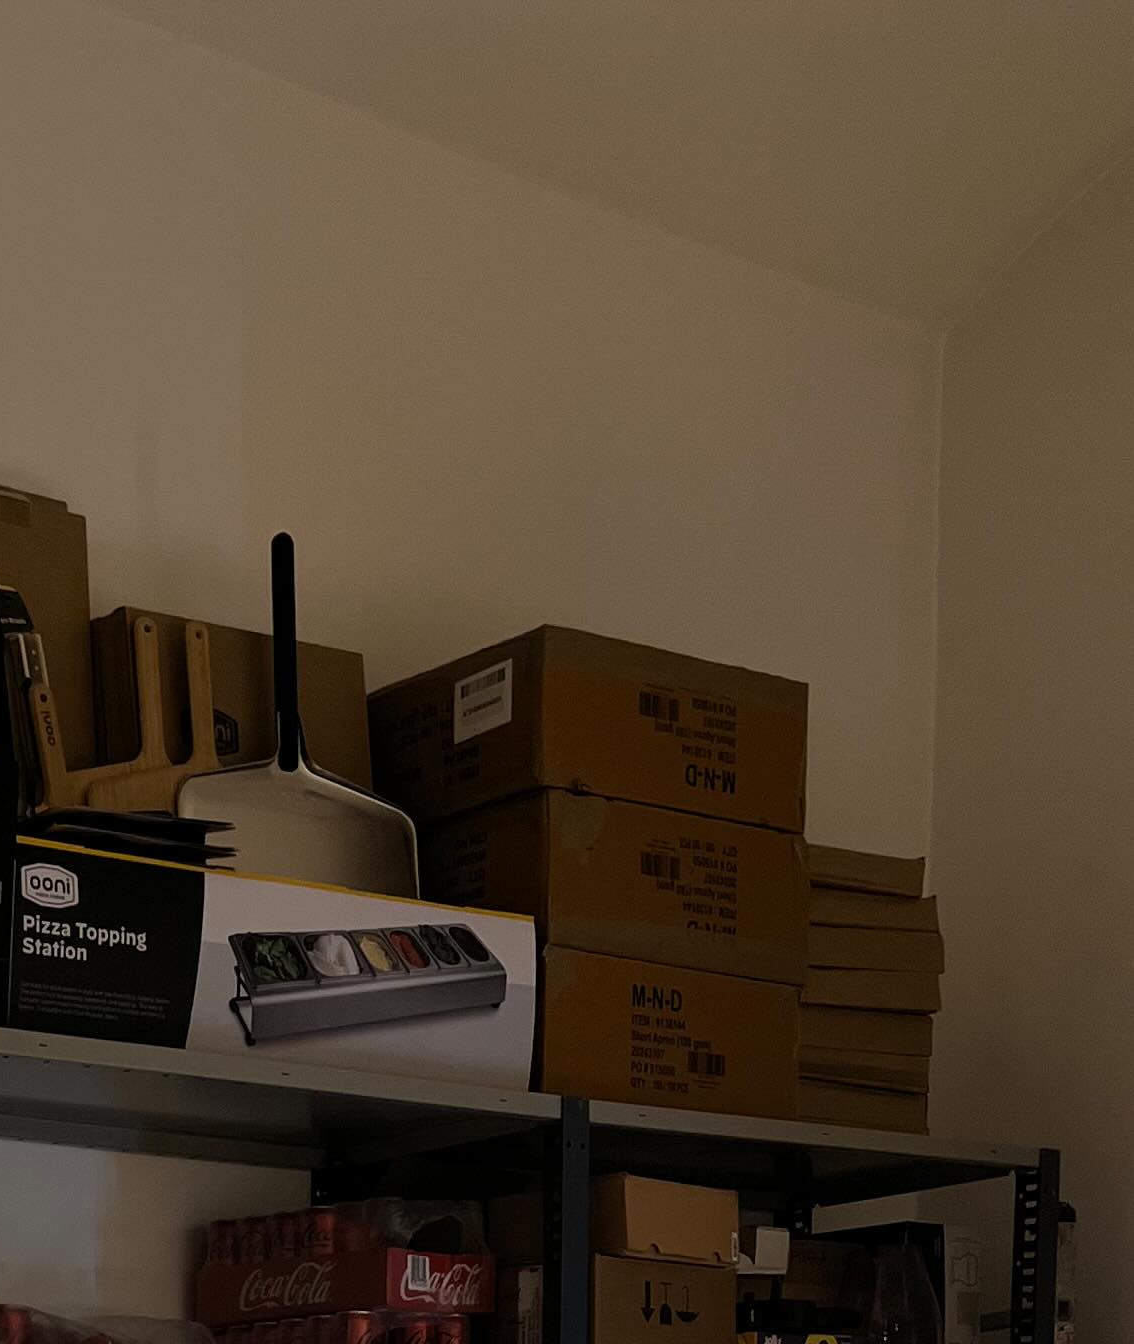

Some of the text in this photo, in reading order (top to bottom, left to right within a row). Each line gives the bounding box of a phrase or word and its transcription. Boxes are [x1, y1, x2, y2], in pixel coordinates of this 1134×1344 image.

[41, 710, 57, 747] ooni
[684, 764, 736, 796] M-N-D
[30, 876, 70, 895] ooni
[22, 914, 148, 953] Pizza Topping
[22, 937, 88, 961] Station
[632, 983, 682, 1012] M-N-D
[239, 1260, 337, 1312] Coca-Cola
